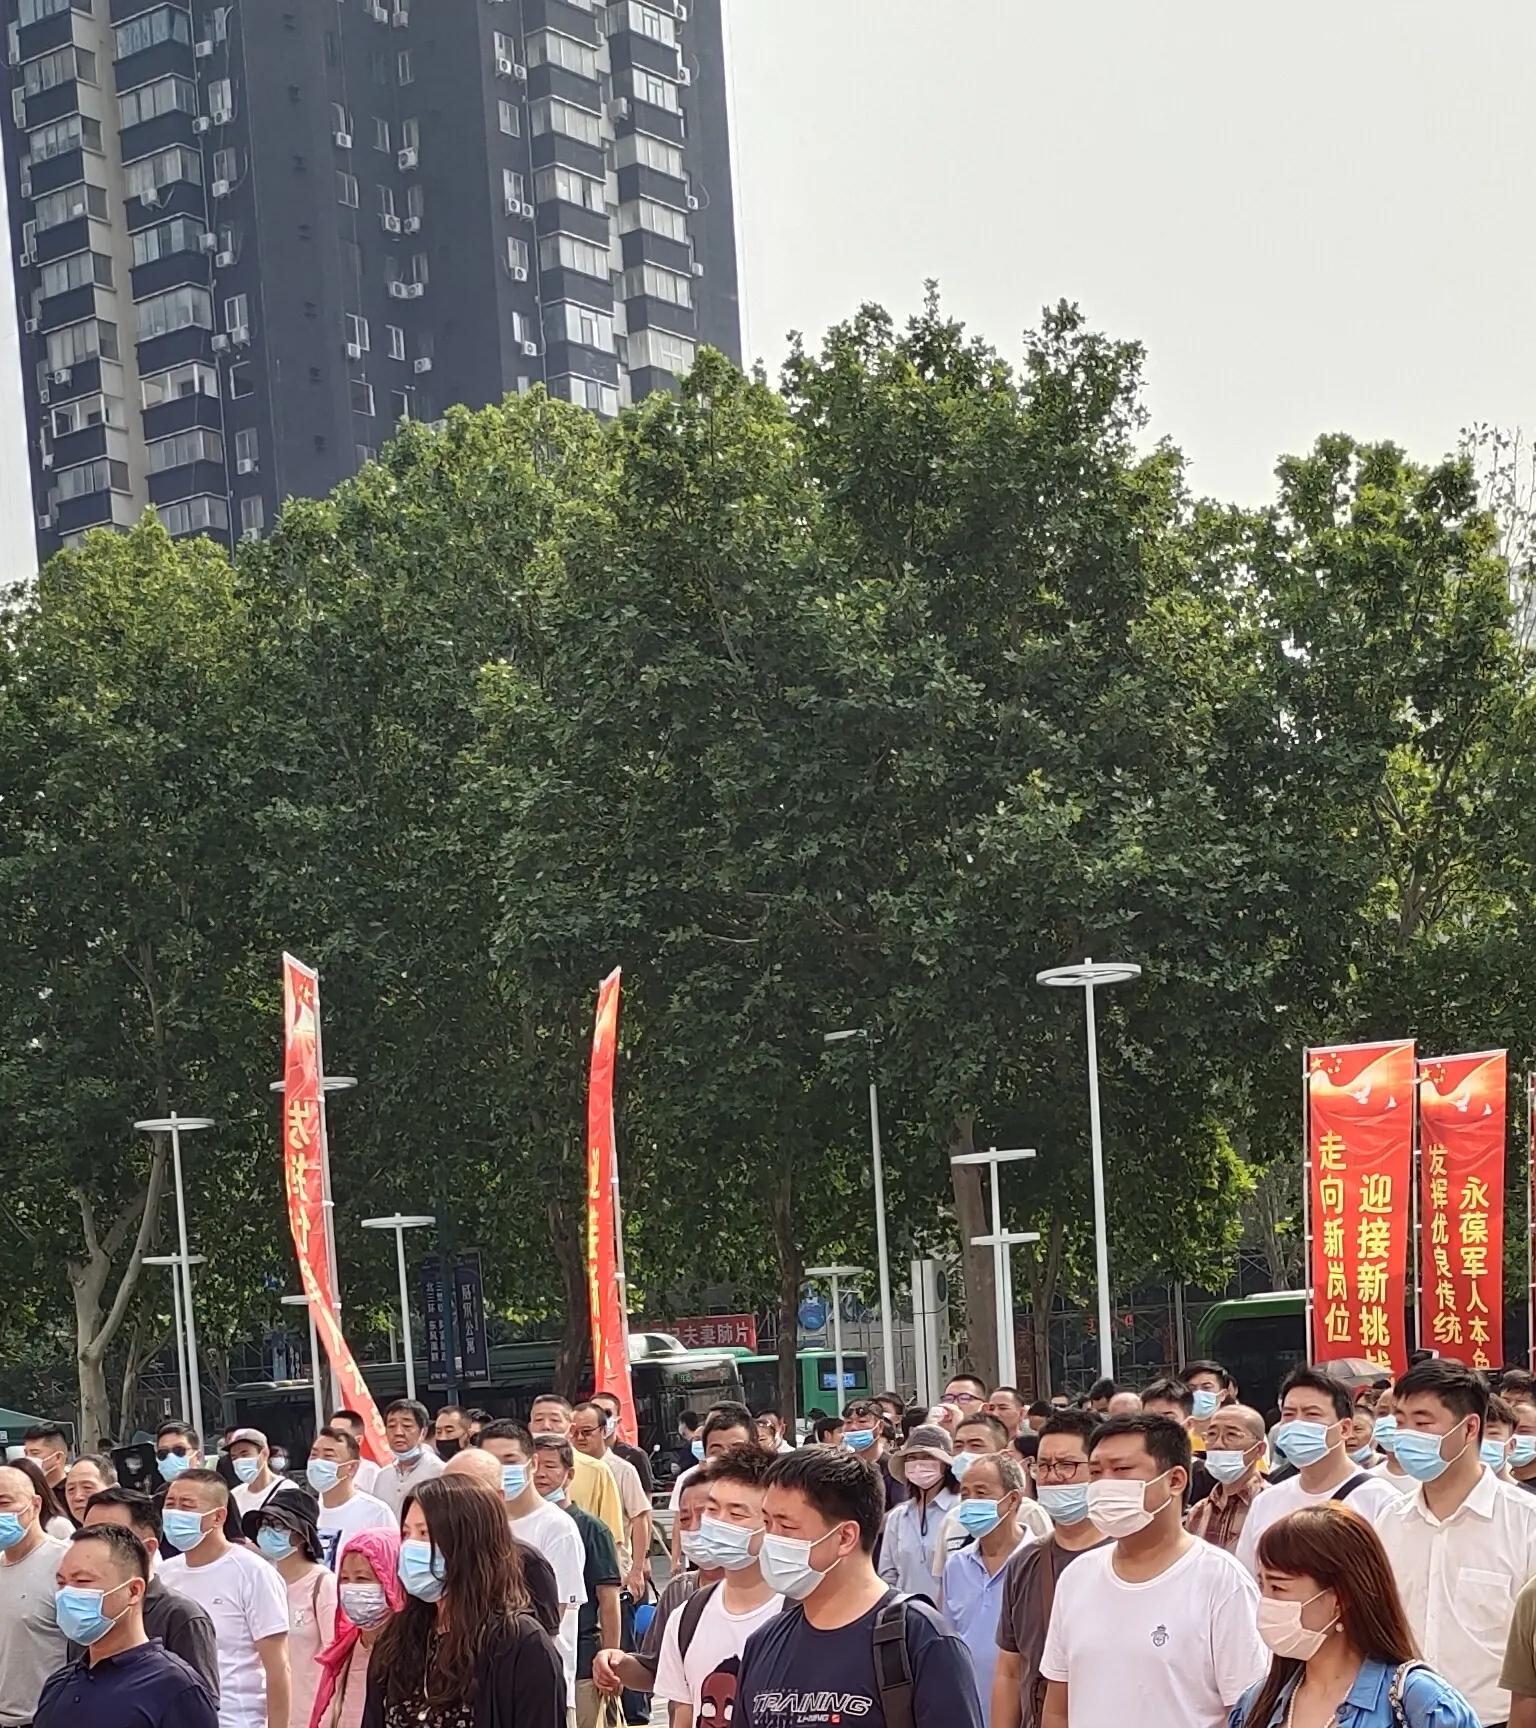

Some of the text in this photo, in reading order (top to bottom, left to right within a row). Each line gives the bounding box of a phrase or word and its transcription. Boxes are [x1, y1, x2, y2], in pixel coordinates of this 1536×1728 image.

[1318, 1131, 1351, 1343] 走向新岗位
[1428, 1144, 1463, 1345] 发挥优良传统
[1459, 1176, 1491, 1369] 永葆军人本色
[753, 1692, 872, 1716] TRAINING
